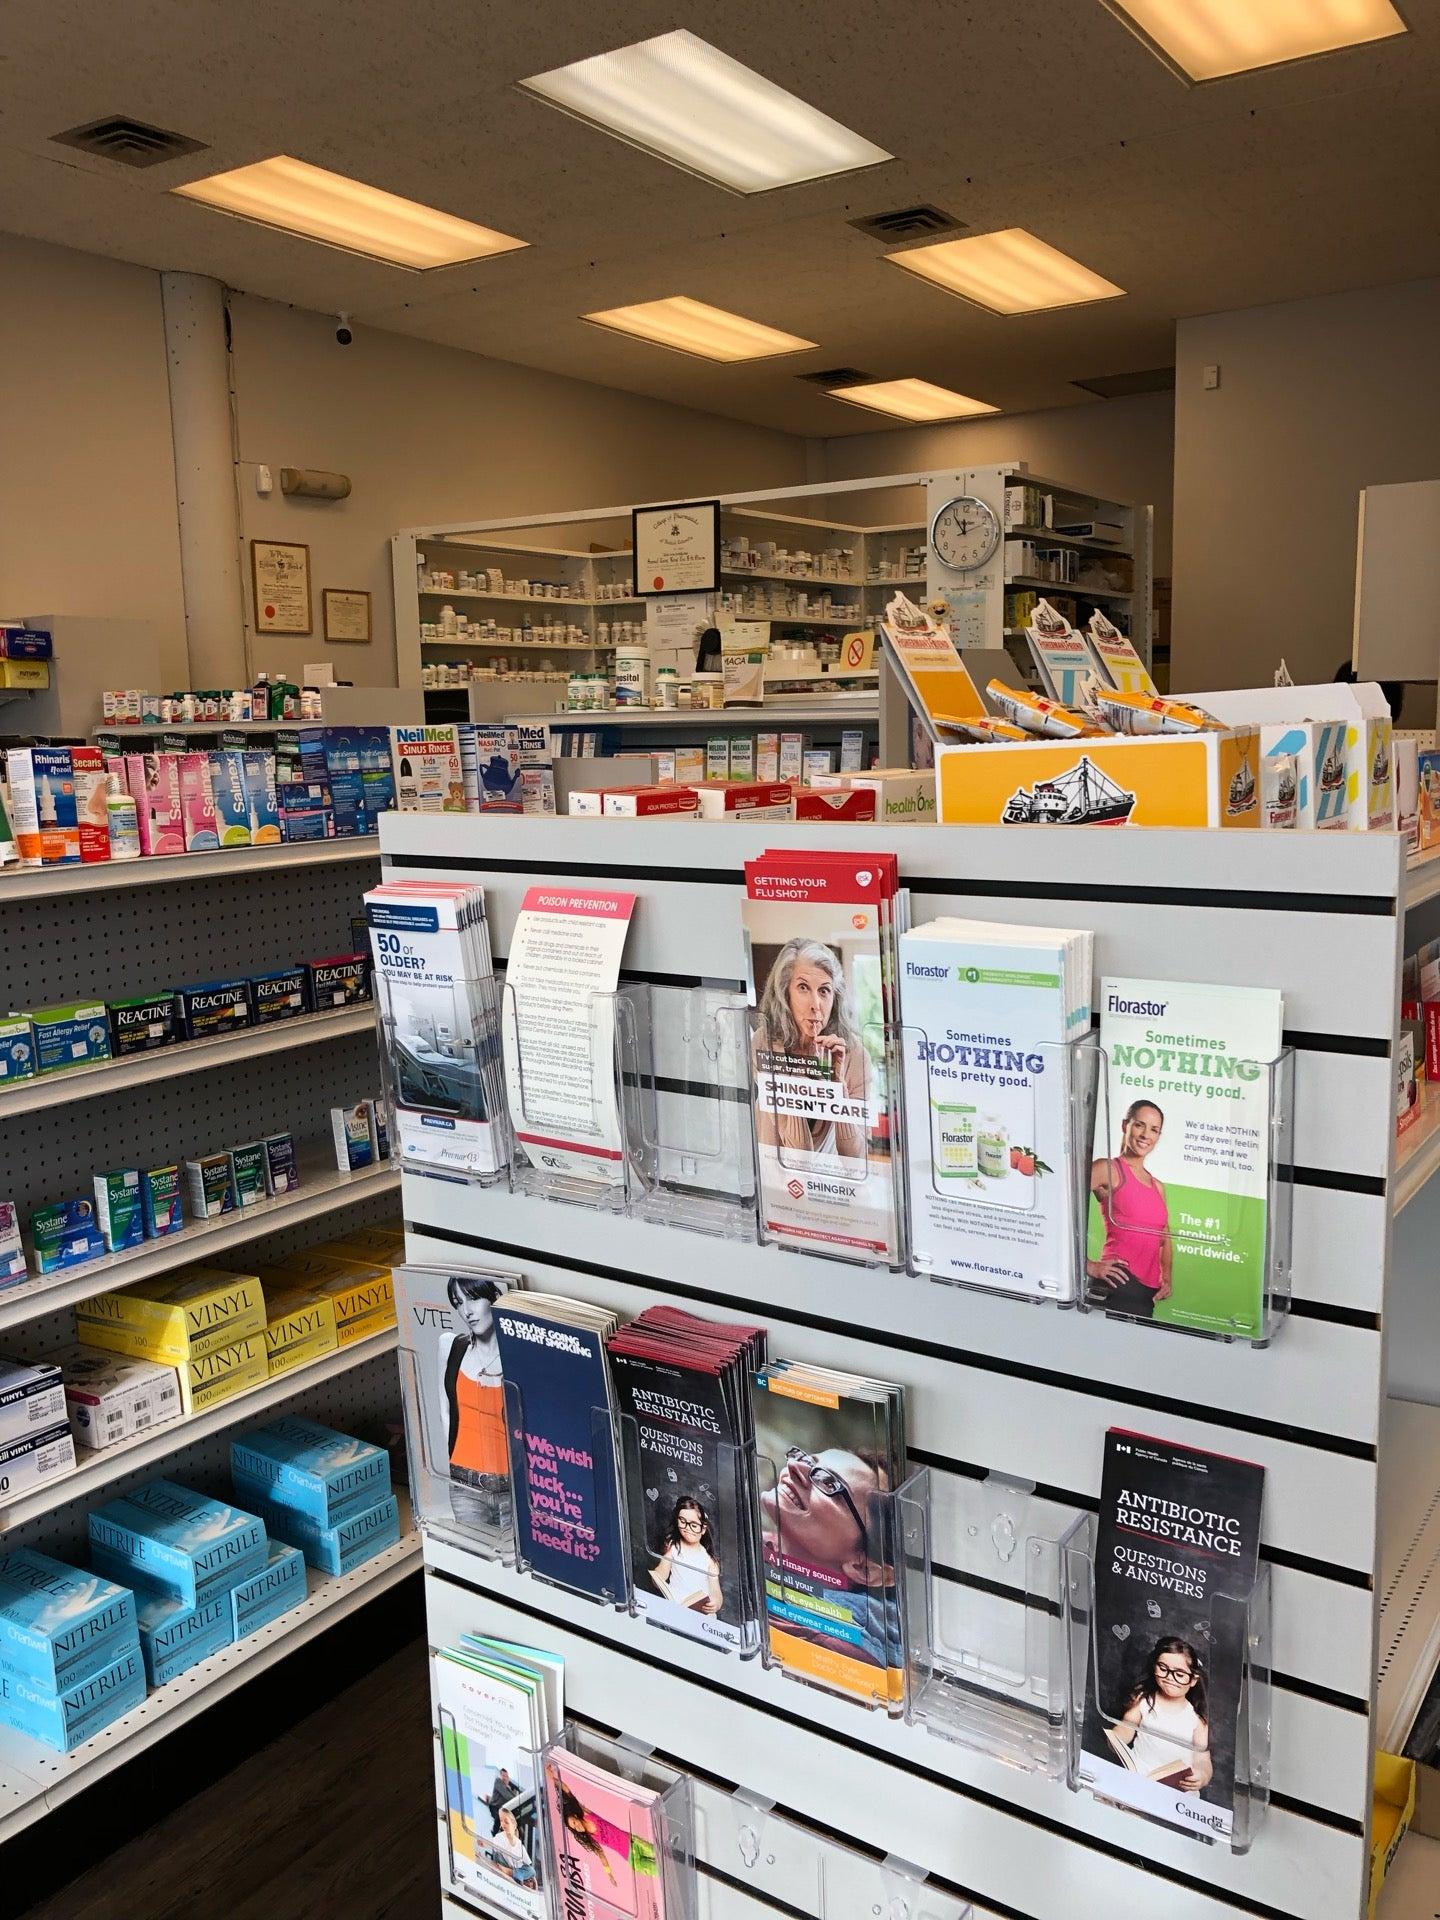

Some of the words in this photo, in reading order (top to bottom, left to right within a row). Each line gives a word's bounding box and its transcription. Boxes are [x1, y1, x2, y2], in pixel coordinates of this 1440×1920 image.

[963, 505, 970, 513] 12
[944, 518, 952, 527] 10
[940, 530, 946, 538] 9
[943, 542, 949, 550] 8
[951, 551, 956, 559] 7
[972, 550, 978, 558] 5
[981, 541, 986, 549] 4
[397, 728, 454, 742] NeilMed
[478, 731, 505, 739] NeilMed
[34, 754, 70, 765] Rhinaris
[73, 759, 102, 768] Secaris
[510, 753, 518, 762] 50
[168, 760, 182, 821] Salinex
[199, 758, 216, 818] Salinex
[227, 757, 246, 814] Salinex
[264, 754, 278, 813] Salinex
[659, 802, 678, 810] PROTECT
[754, 877, 798, 886] GETTING
[799, 878, 827, 888] YOUR
[537, 896, 568, 907] POISON
[569, 898, 618, 912] PREVENTION
[755, 889, 775, 898] FLU
[776, 890, 809, 899] SHOT?
[377, 933, 400, 954] 50
[403, 946, 414, 955] or
[380, 954, 425, 970] OLDER?
[906, 962, 950, 978] Florastor
[315, 963, 365, 983] REACTINE
[382, 969, 396, 977] YOU
[397, 970, 412, 979] MAY
[257, 978, 303, 998] REACTINE
[192, 990, 244, 1010] REACTINE
[1108, 995, 1167, 1016] Florastor
[118, 1006, 173, 1026] REACTINE
[38, 1030, 52, 1040] Fast
[52, 1026, 73, 1037] Allergy
[73, 1022, 91, 1033] Relief
[946, 1029, 1012, 1047] Sometimes
[1146, 1030, 1227, 1051] Sometimes
[775, 1055, 788, 1064] cut
[788, 1057, 806, 1066] back
[917, 1040, 1045, 1074] NOTHING
[1112, 1044, 1261, 1082] NOTHING
[786, 1065, 805, 1074] trans
[930, 1065, 958, 1079] feels
[960, 1071, 996, 1086] pretty
[999, 1077, 1032, 1088] good.
[765, 1081, 835, 1099] SHINGLES
[1120, 1073, 1155, 1089] feels
[1158, 1078, 1202, 1097] pretty
[1206, 1086, 1246, 1100] good.
[766, 1096, 827, 1113] DOESN'T
[830, 1104, 870, 1119] CARE
[942, 1132, 974, 1143] Florastor
[1206, 1122, 1224, 1133] take
[1184, 1133, 1199, 1142] any
[1200, 1134, 1215, 1144] day
[235, 1152, 262, 1166] Systane
[1183, 1154, 1203, 1164] think
[1204, 1158, 1219, 1167] you
[1220, 1150, 1235, 1158] and
[1236, 1151, 1249, 1159] we
[204, 1164, 228, 1178] Systane
[150, 1174, 179, 1190] Systane
[807, 1181, 856, 1197] SHINGRIX
[110, 1186, 139, 1203] Systane
[36, 1214, 68, 1234] Systane
[1179, 1213, 1202, 1227] The
[1205, 1217, 1220, 1230] #1
[950, 1259, 1024, 1280] www.florastor.ca
[189, 1290, 254, 1329] VINYL
[337, 1283, 394, 1318] VINYL
[413, 1307, 454, 1330] VTE
[267, 1311, 325, 1347] VINYL
[499, 1317, 513, 1330] SO
[513, 1320, 548, 1339] YOU'RE
[548, 1329, 581, 1347] GOING
[193, 1340, 211, 1354] 100
[501, 1325, 515, 1338] TO
[516, 1329, 546, 1345] START
[546, 1338, 593, 1359] SMOKING
[191, 1340, 256, 1381] VINYL
[271, 1357, 287, 1371] 100
[756, 1377, 767, 1387] BC
[0, 1390, 25, 1404] VINYL
[195, 1390, 213, 1406] 100
[631, 1387, 716, 1420] ANTIBIOTIC
[634, 1399, 722, 1435] RESISTANCE
[10, 1442, 34, 1457] VINYL
[639, 1425, 704, 1455] QUESTIONS
[555, 1442, 594, 1471] wish
[640, 1438, 649, 1449] &
[649, 1440, 703, 1467] ANSWERS
[233, 1448, 283, 1484] NITRILE
[527, 1451, 558, 1475] you
[327, 1458, 385, 1498] NITRILE
[529, 1470, 584, 1502] luck...
[530, 1490, 583, 1520] you're
[1117, 1489, 1241, 1536] ANTIBIOTIC
[339, 1503, 394, 1546] NITRILE
[1116, 1507, 1242, 1557] RESISTANCE
[91, 1519, 147, 1561] NITRILE
[531, 1527, 574, 1553] need
[193, 1528, 261, 1577] NITRILE
[768, 1553, 776, 1562] A
[812, 1570, 842, 1586] source
[1113, 1545, 1207, 1583] QUESTIONS
[235, 1560, 300, 1609] NITRILE
[783, 1575, 794, 1586] all
[794, 1580, 815, 1593] your
[1112, 1562, 1123, 1575] &
[1125, 1565, 1205, 1600] ANSWERS
[799, 1597, 815, 1609] eye
[815, 1601, 842, 1619] health
[53, 1600, 128, 1659] NITRILE
[154, 1600, 224, 1653] NITRILE
[772, 1604, 787, 1616] and
[788, 1610, 823, 1630] eyewear
[824, 1623, 853, 1641] needs.
[59, 1671, 77, 1689] 100
[63, 1656, 138, 1717] NITRILE
